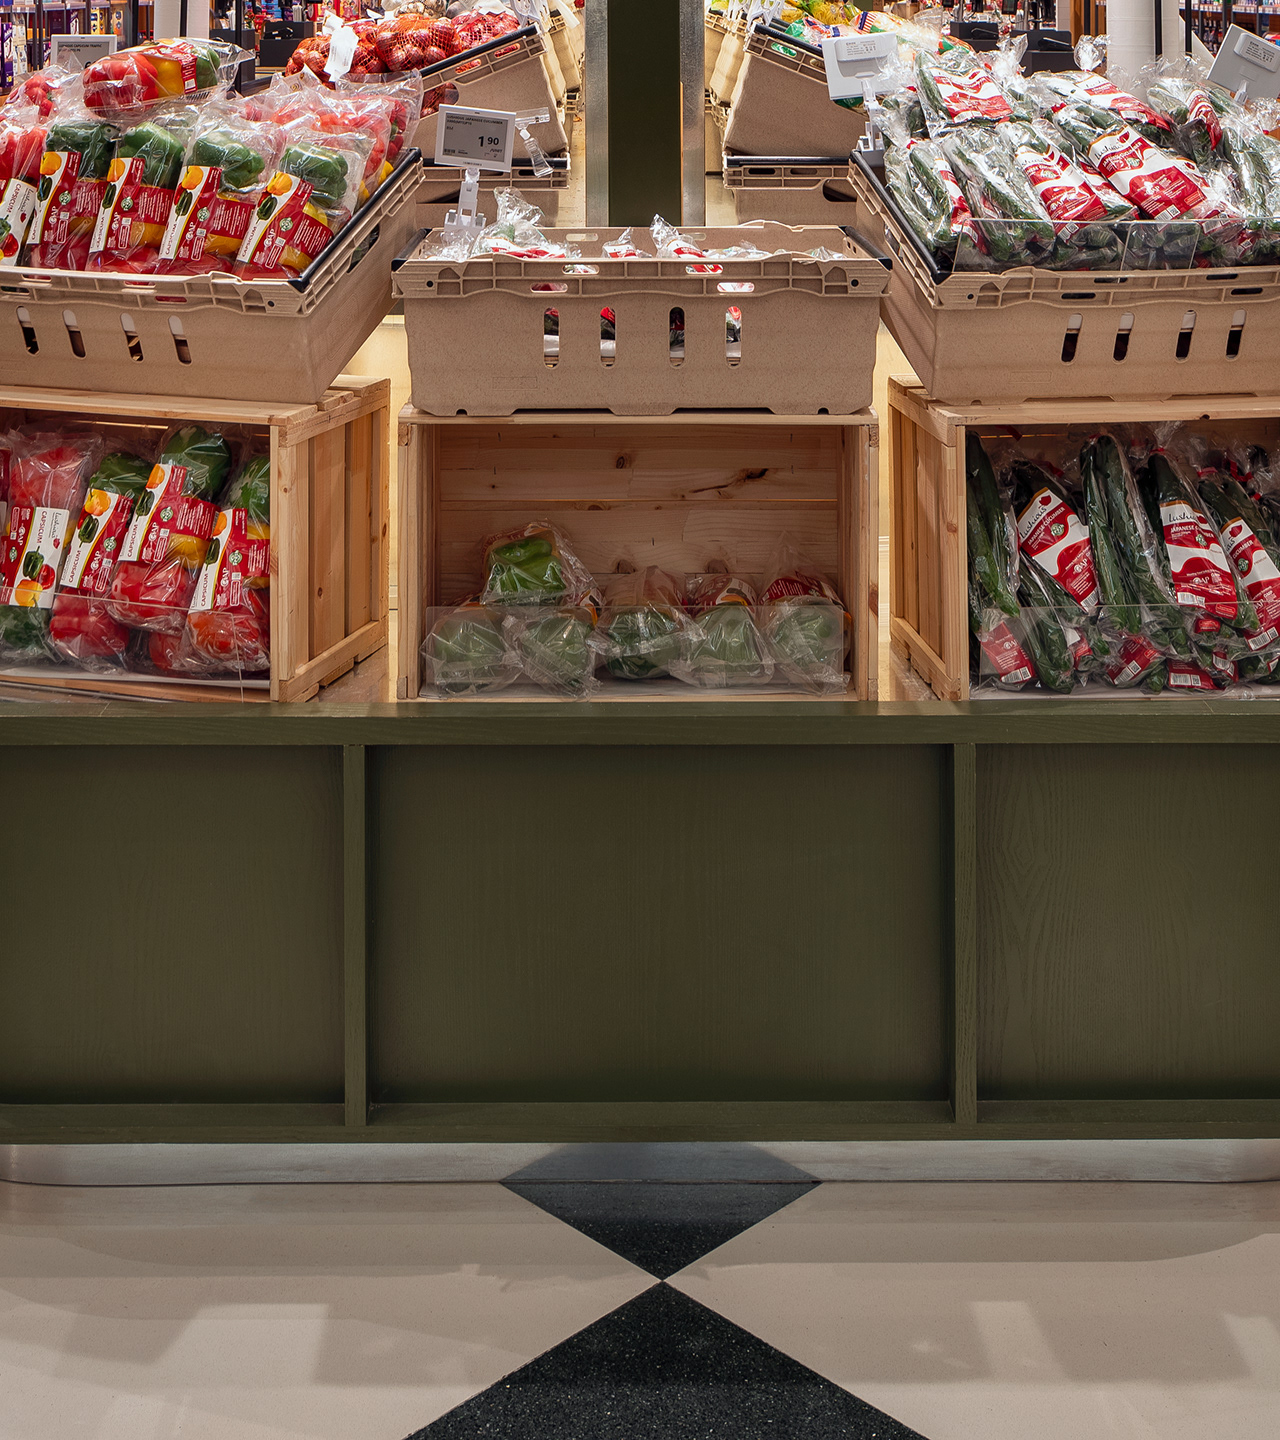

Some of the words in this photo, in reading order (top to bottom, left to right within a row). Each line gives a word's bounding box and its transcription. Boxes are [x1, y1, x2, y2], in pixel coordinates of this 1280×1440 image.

[487, 137, 499, 145] 90
[7, 183, 21, 213] CAPSICUM
[37, 510, 48, 544] CAPSICUM
[1043, 506, 1066, 526] CUCUMBER
[1170, 524, 1194, 533] JAPANESE
[127, 523, 139, 558] CAPSICUM
[68, 550, 82, 583] CAPSICUM
[200, 573, 209, 607] CAPSICUM
